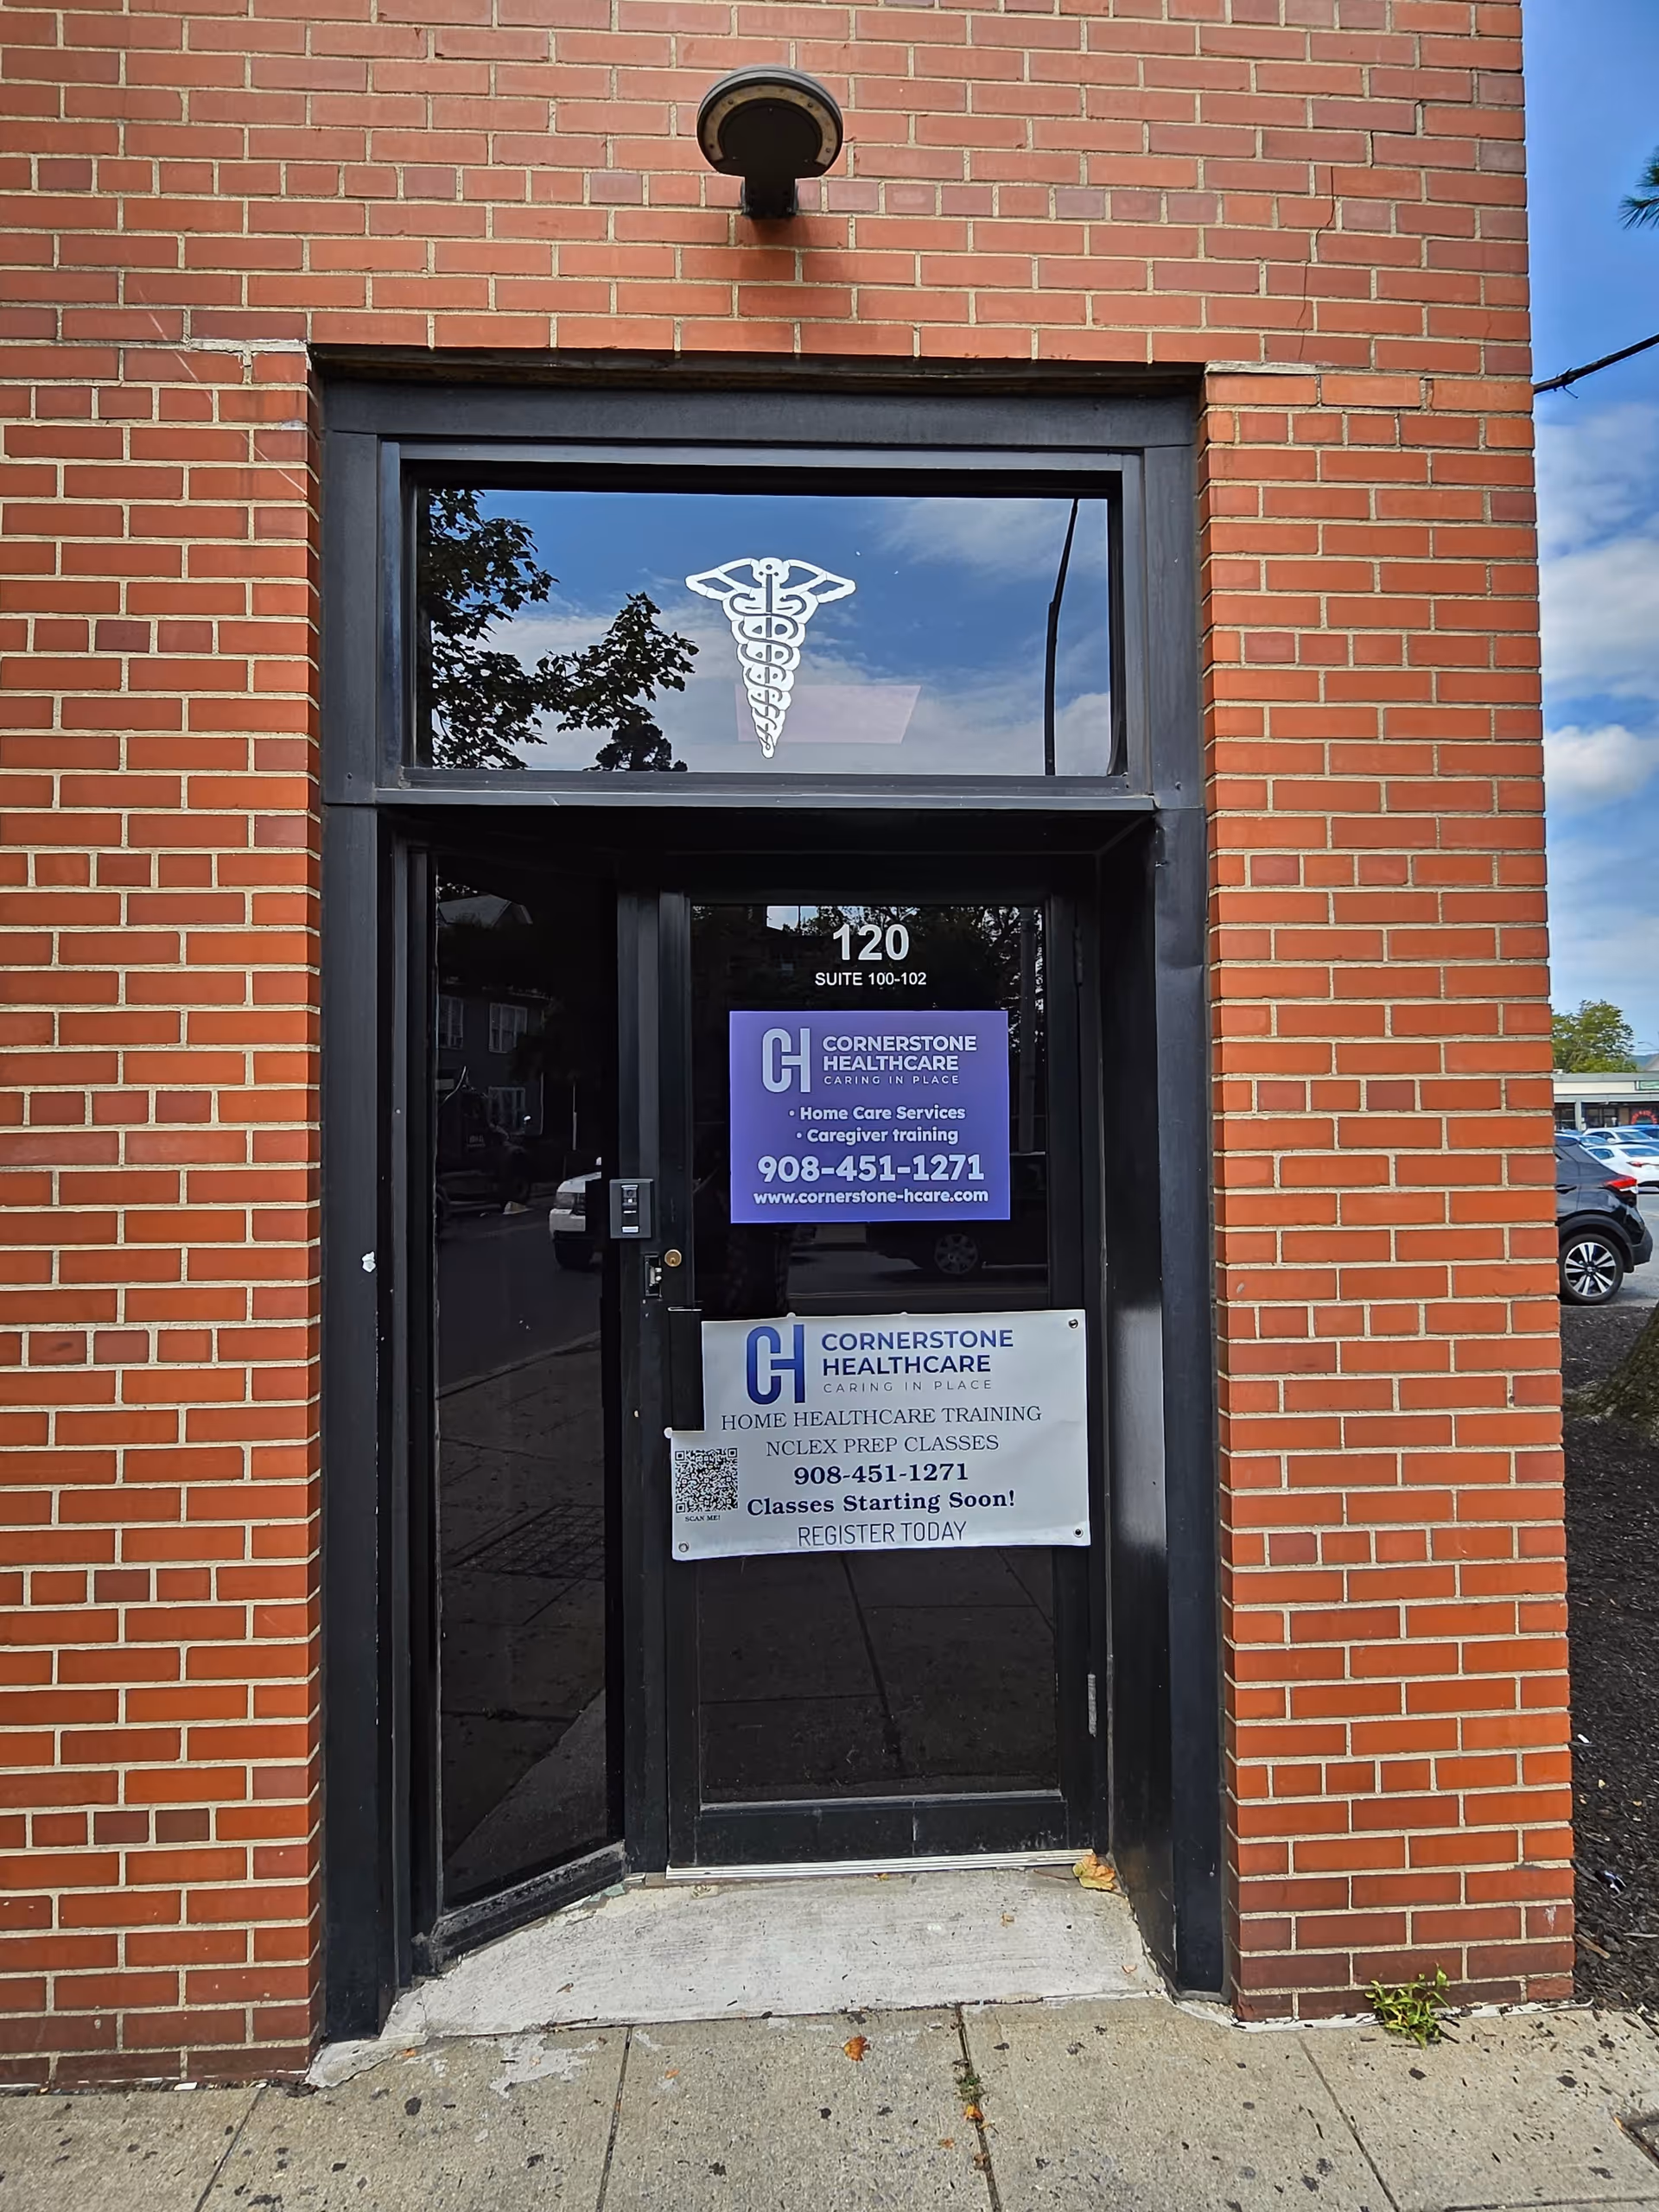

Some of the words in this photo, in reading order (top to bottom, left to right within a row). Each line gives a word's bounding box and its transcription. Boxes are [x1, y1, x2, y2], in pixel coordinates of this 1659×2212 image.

[832, 923, 910, 961] 120
[815, 972, 863, 986] SUITE
[868, 972, 927, 986] 100-102
[823, 1035, 977, 1052] CORNERSTONE
[762, 1027, 810, 1093] CH
[823, 1055, 959, 1071] HEALTHCARE
[824, 1075, 880, 1085] CARING
[889, 1075, 904, 1085] IN
[912, 1075, 960, 1085] PLACE
[800, 1106, 849, 1121] Home
[853, 1106, 892, 1121] Care
[896, 1104, 966, 1120] Services
[806, 1128, 888, 1146] Caregiver
[893, 1127, 958, 1145] training
[757, 1154, 985, 1183] 908-451-1271
[753, 1188, 988, 1205] www.cornerstone-hcare.com
[821, 1329, 1014, 1352] CORNERSTONE
[746, 1324, 806, 1405] CH
[823, 1355, 991, 1376] HEALTHCARE
[823, 1381, 893, 1394] CARING
[905, 1381, 922, 1391] IN
[934, 1379, 992, 1390] PLACE
[721, 1413, 787, 1431] HOME
[793, 1408, 936, 1427] HEALTHCARE
[942, 1406, 1042, 1424] TRAINING
[766, 1439, 838, 1457] NCLEX
[844, 1437, 898, 1454] PREP
[904, 1434, 1000, 1452] CLASSES
[793, 1463, 969, 1485] 908-451-1271
[747, 1497, 835, 1516] Classes
[842, 1493, 940, 1515] Starting
[949, 1490, 1015, 1509] Soon!
[798, 1522, 895, 1547] REGISTER
[900, 1520, 967, 1542] TODAY
